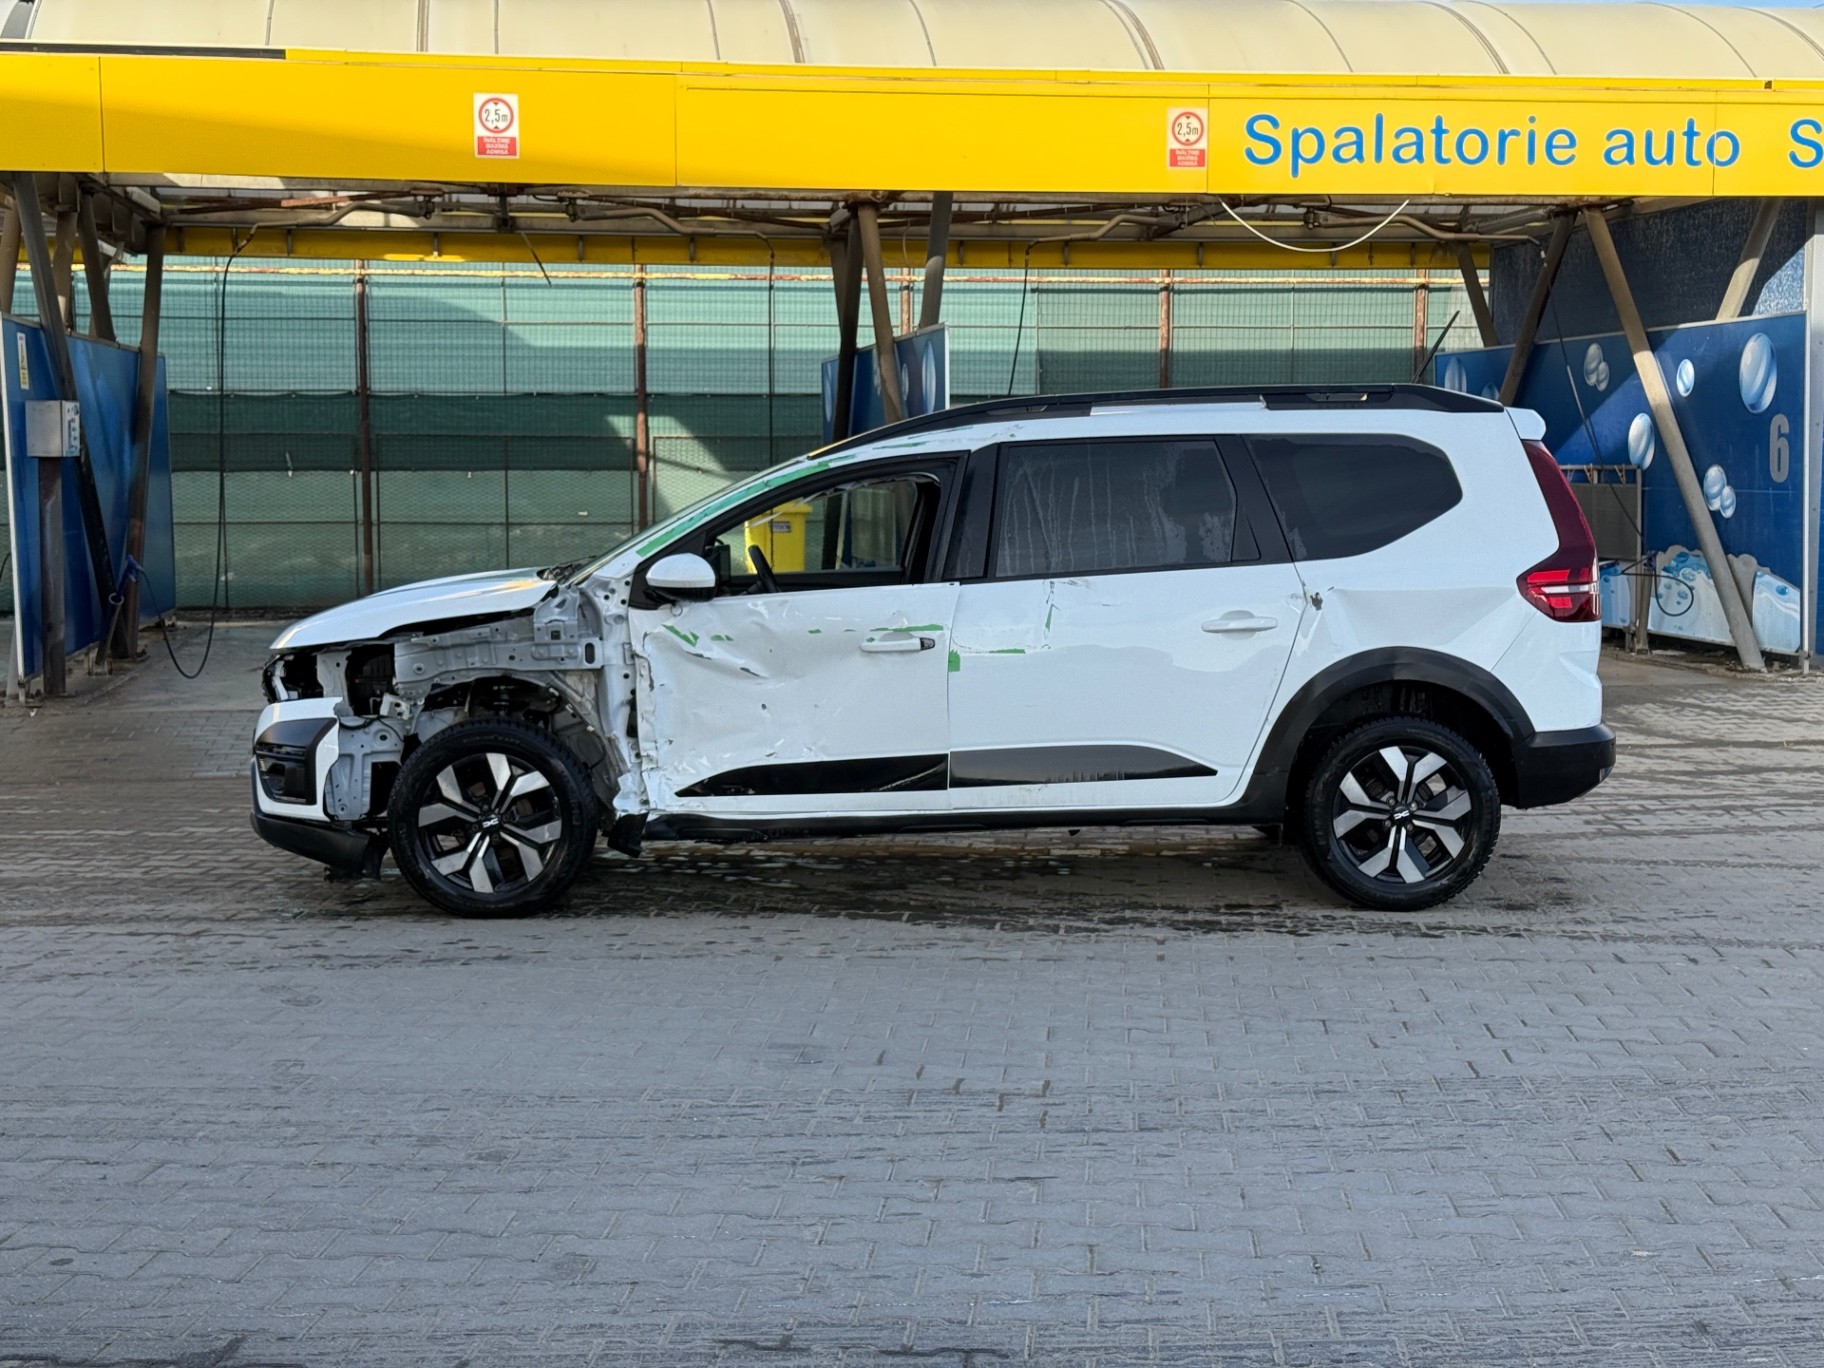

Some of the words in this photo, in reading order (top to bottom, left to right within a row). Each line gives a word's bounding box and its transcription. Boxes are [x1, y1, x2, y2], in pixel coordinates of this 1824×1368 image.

[1245, 114, 1577, 177] Spalatorie
[1603, 118, 1740, 167] auto
[1769, 413, 1790, 483] 6
